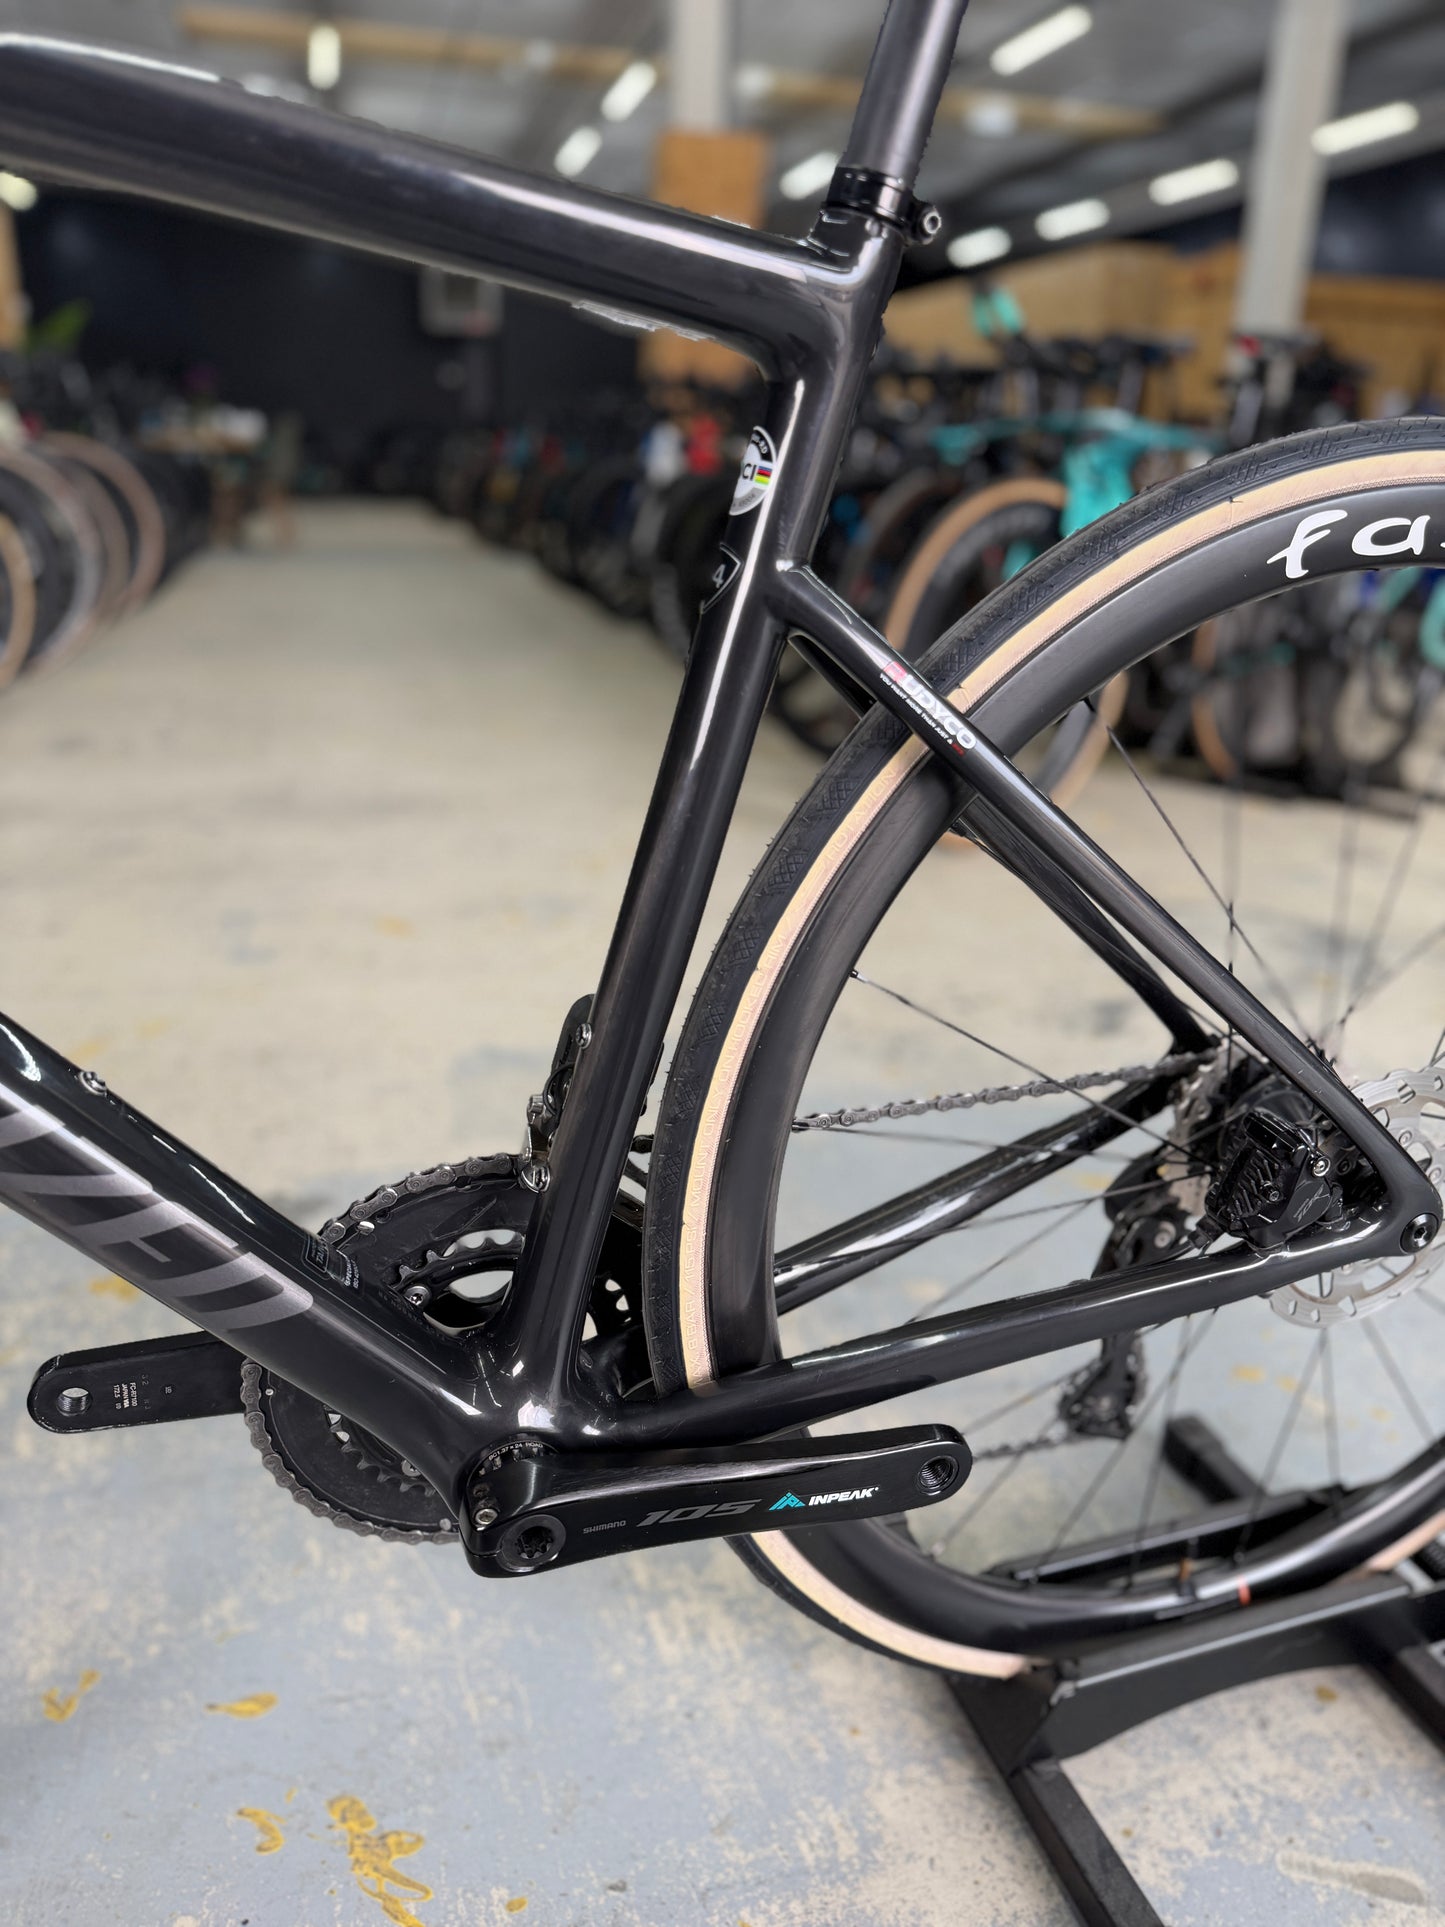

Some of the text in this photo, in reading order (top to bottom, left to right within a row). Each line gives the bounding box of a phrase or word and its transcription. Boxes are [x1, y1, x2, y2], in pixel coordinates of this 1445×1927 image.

[1267, 509, 1445, 578] fa
[884, 661, 977, 749] RUDYCO
[825, 769, 897, 861] ROTATION
[763, 935, 786, 969] RIM
[725, 972, 768, 1059] HOOKED
[719, 1055, 735, 1082] ON
[703, 1089, 723, 1136] ONLY
[691, 1142, 709, 1207] MOUNT
[686, 1227, 697, 1254] PSI
[685, 1257, 695, 1283] 115
[685, 1300, 697, 1336] BAR
[637, 1499, 762, 1527] 105
[808, 1487, 877, 1506] INPEAK
[583, 1520, 626, 1534] SHIMANO
